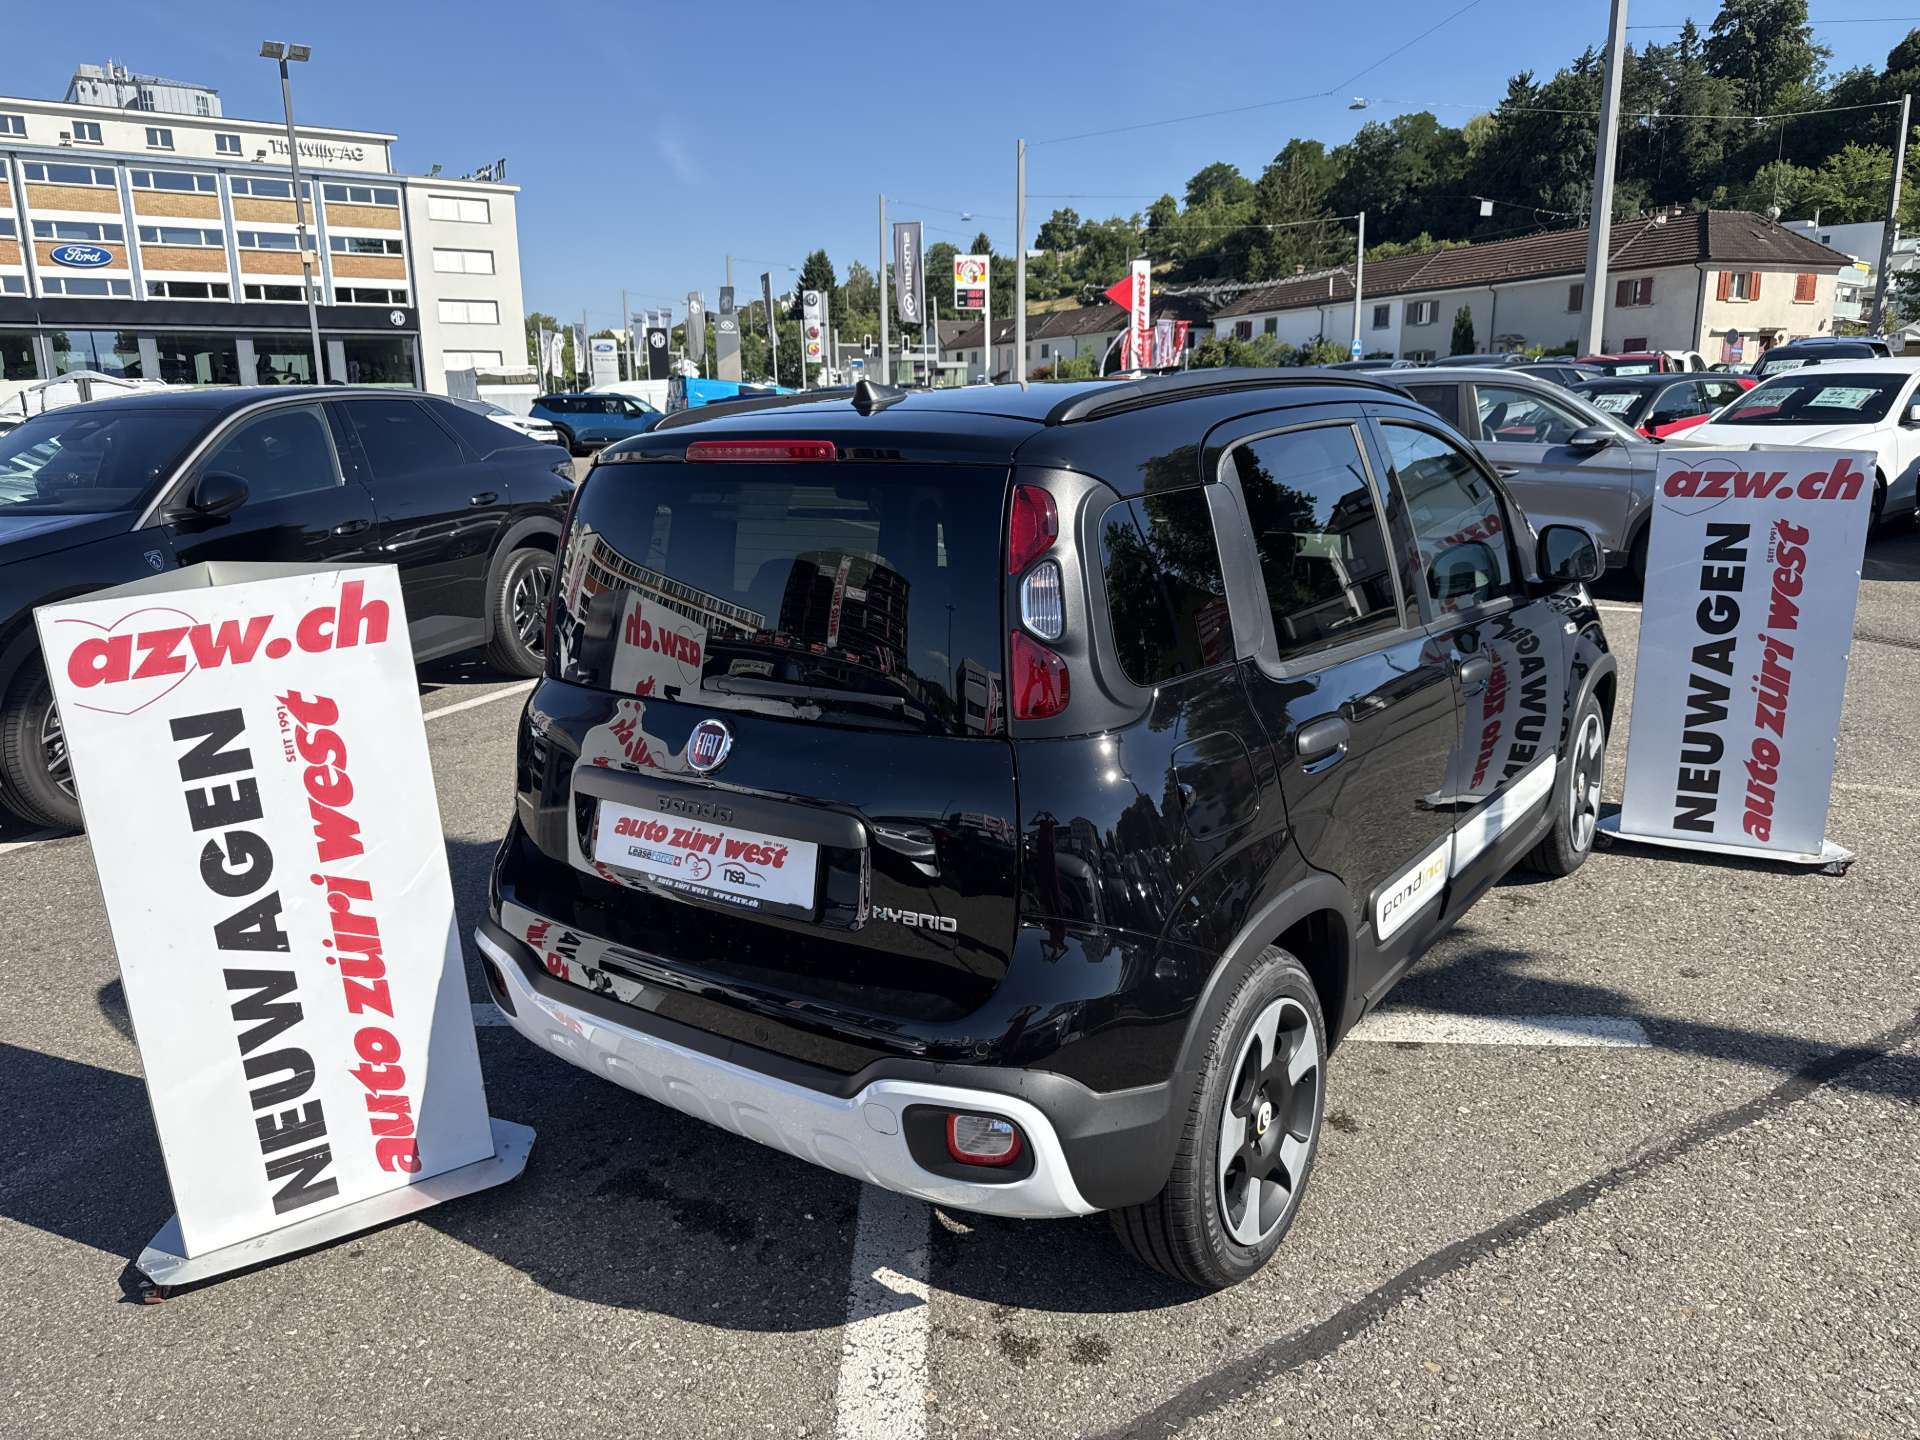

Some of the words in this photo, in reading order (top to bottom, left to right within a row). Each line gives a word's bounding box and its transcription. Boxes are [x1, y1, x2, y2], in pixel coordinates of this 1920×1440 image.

[299, 142, 335, 162] Willy
[340, 145, 364, 161] AG
[64, 246, 101, 262] Ford
[650, 332, 666, 349] MG
[1664, 458, 1865, 500] azw.ch
[1769, 527, 1778, 545] 1991
[1767, 547, 1776, 563] SEIT
[1767, 518, 1810, 630] west
[67, 580, 390, 688] azw.ch
[1673, 522, 1751, 833] NEUWAGEN
[1752, 633, 1795, 738] züri
[276, 705, 291, 734] 1991
[282, 738, 297, 763] SEIT
[695, 732, 722, 757] FIAT
[274, 689, 365, 863] west
[1742, 738, 1782, 842] auto
[657, 795, 734, 823] panda
[614, 816, 669, 843] auto
[667, 826, 725, 855] züri
[725, 838, 789, 869] west
[691, 886, 709, 896] west
[723, 868, 745, 885] nsa
[1382, 857, 1444, 923] pandino
[872, 905, 958, 933] HYBRID
[169, 707, 339, 1215] NEUWAGEN
[310, 873, 394, 1018] züri
[347, 1026, 422, 1174] auto
